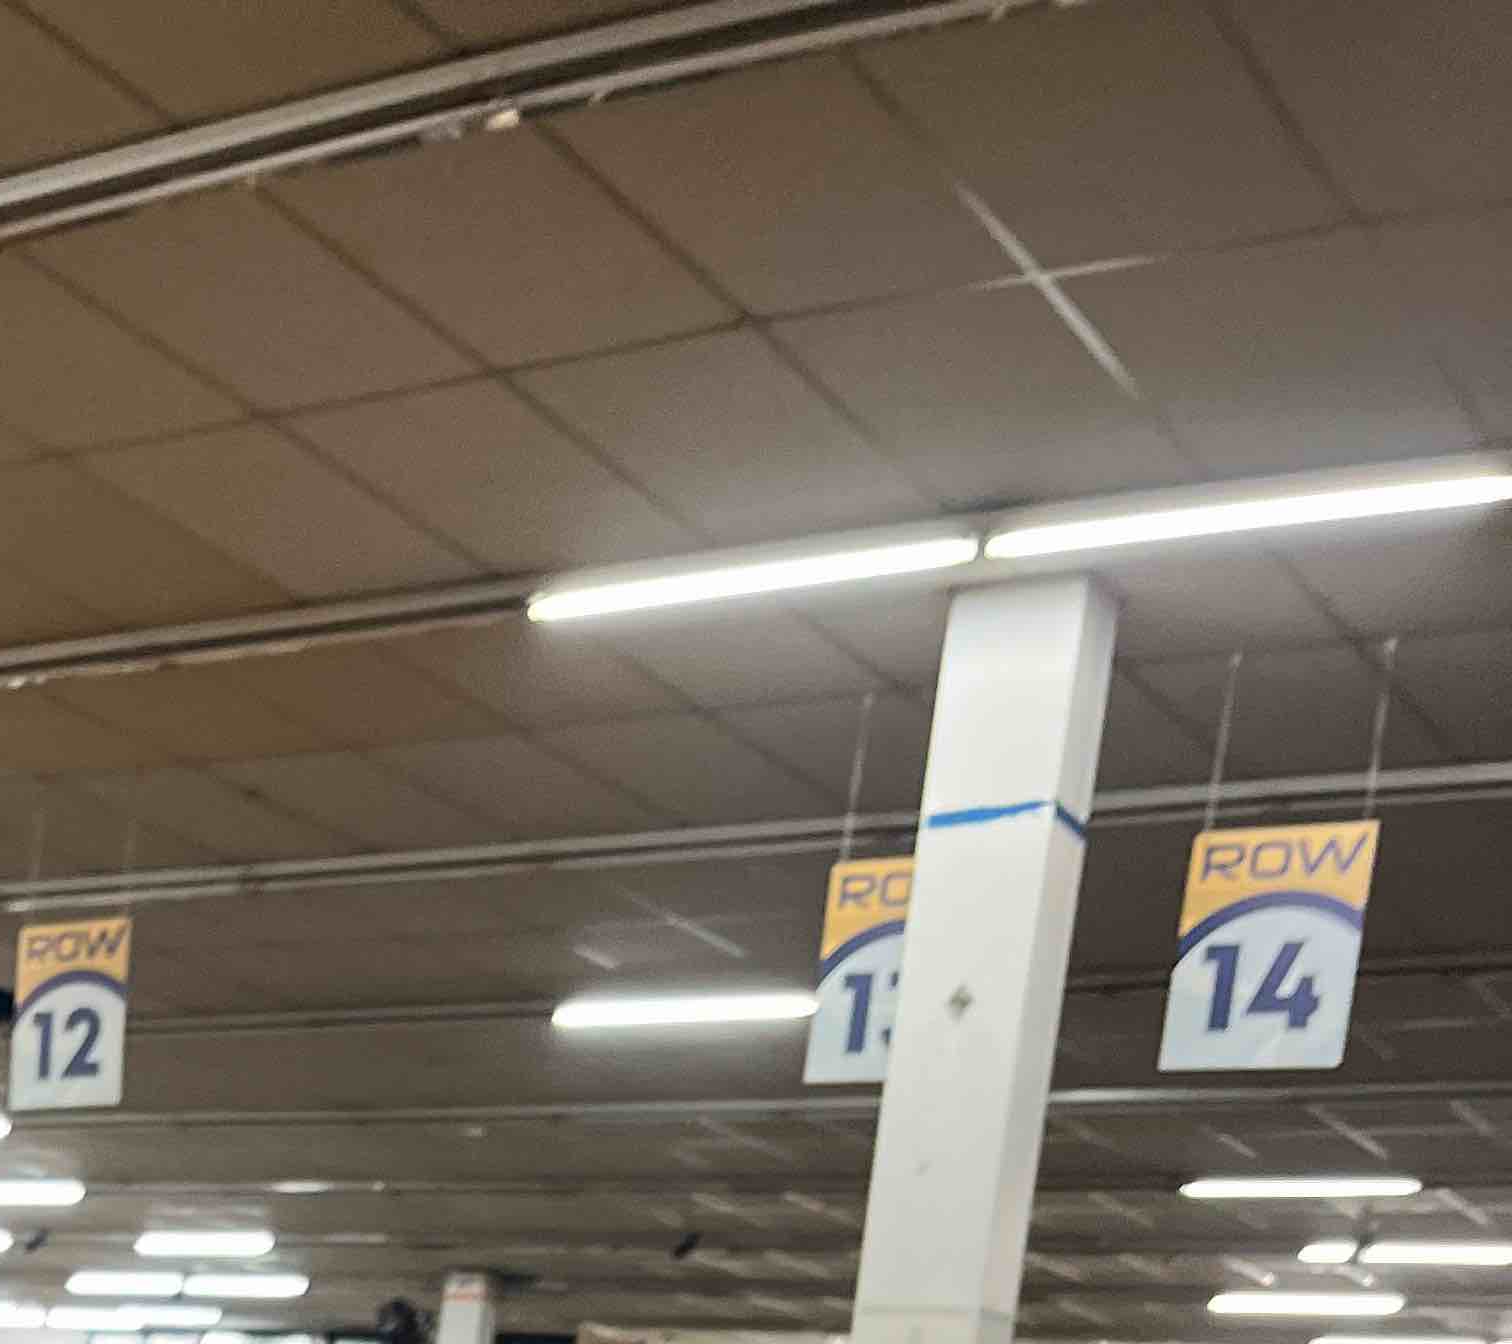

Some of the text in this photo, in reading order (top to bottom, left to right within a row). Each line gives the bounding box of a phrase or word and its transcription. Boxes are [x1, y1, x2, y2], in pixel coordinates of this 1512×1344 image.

[1200, 833, 1368, 882] ROW
[838, 873, 914, 908] RO
[25, 926, 126, 964] ROW
[1202, 942, 1320, 1033] 14
[33, 1007, 101, 1081] 12
